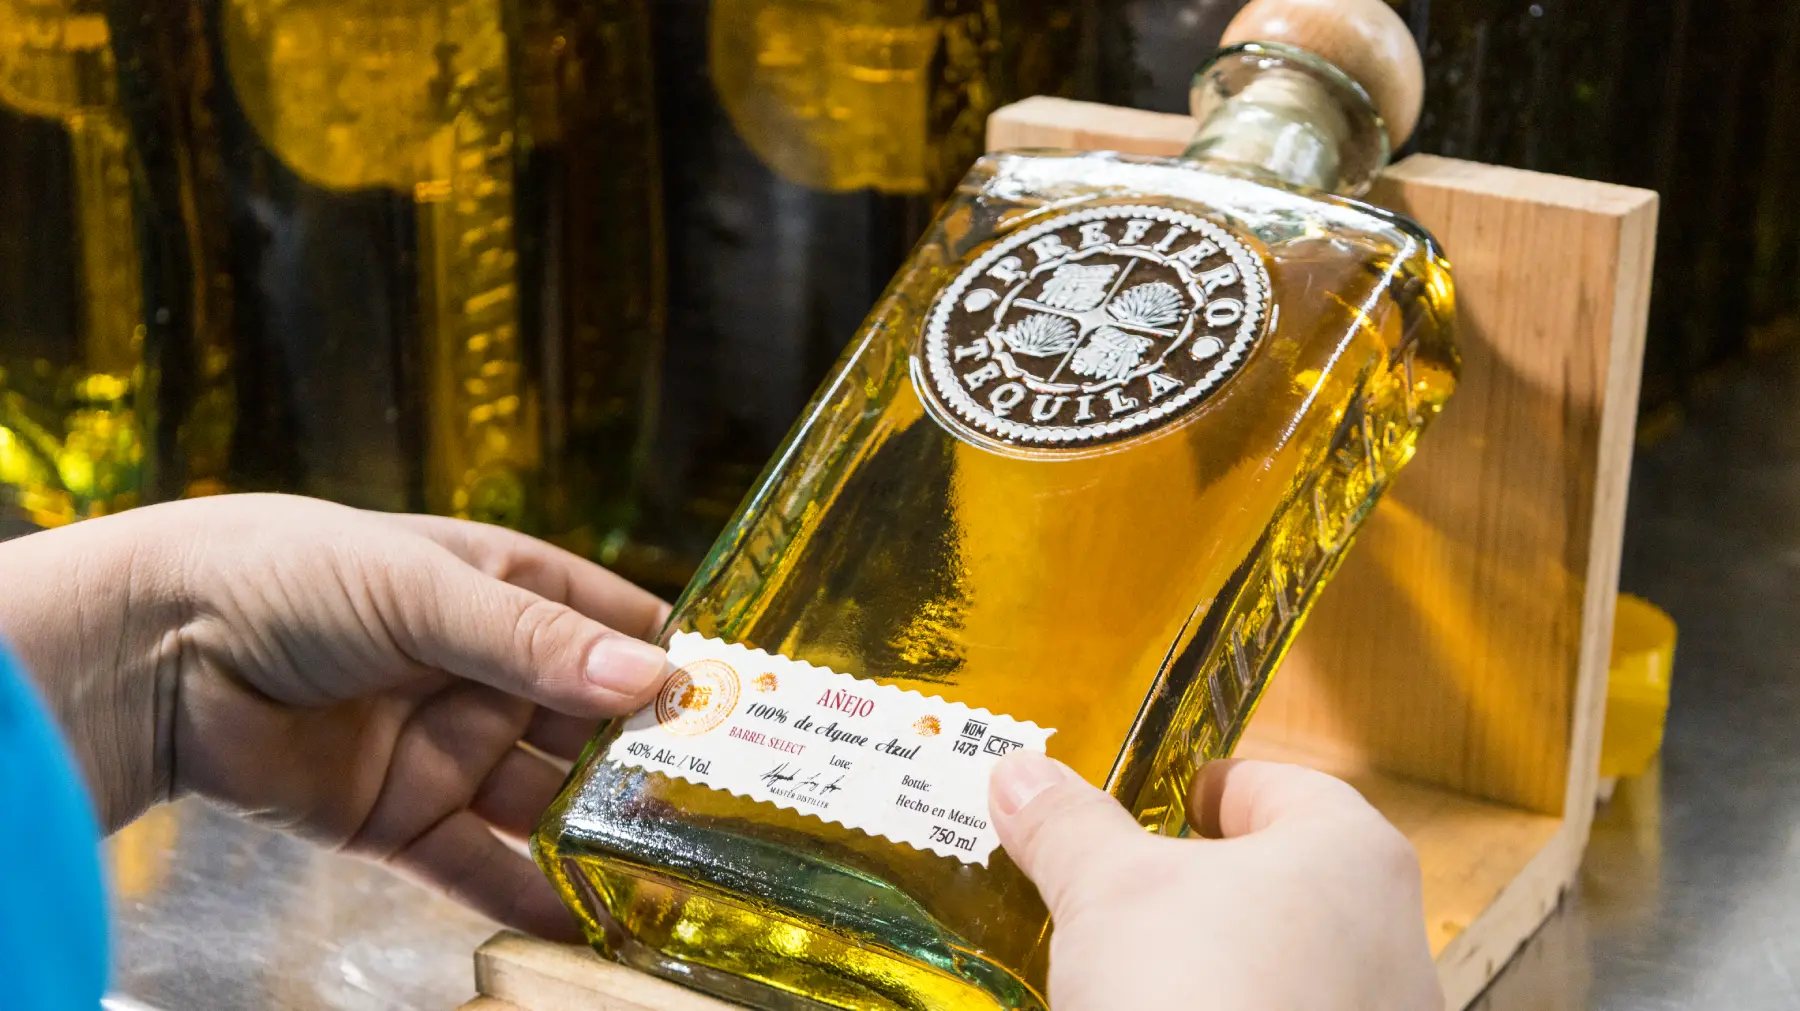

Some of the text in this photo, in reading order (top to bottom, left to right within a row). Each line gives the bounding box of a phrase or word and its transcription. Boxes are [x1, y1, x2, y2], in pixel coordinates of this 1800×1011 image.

[986, 219, 1245, 328] PREFIERO
[955, 338, 1184, 422] TEQUILA
[816, 689, 875, 718] AÑEJO
[729, 727, 806, 756] BARREL SELECT
[746, 702, 922, 760] 100% de Agave Azul
[961, 721, 988, 738] NOM
[627, 741, 652, 759] 40%
[652, 749, 675, 767] Alc.
[690, 757, 712, 775] Vol.
[952, 740, 979, 756] 1473
[829, 754, 853, 770] Lote:
[901, 774, 932, 792] Bottle:
[769, 787, 829, 809] MASTER DISTILLER
[896, 794, 929, 815] Hecho
[931, 806, 946, 818] en
[928, 825, 977, 852] 750 ml
